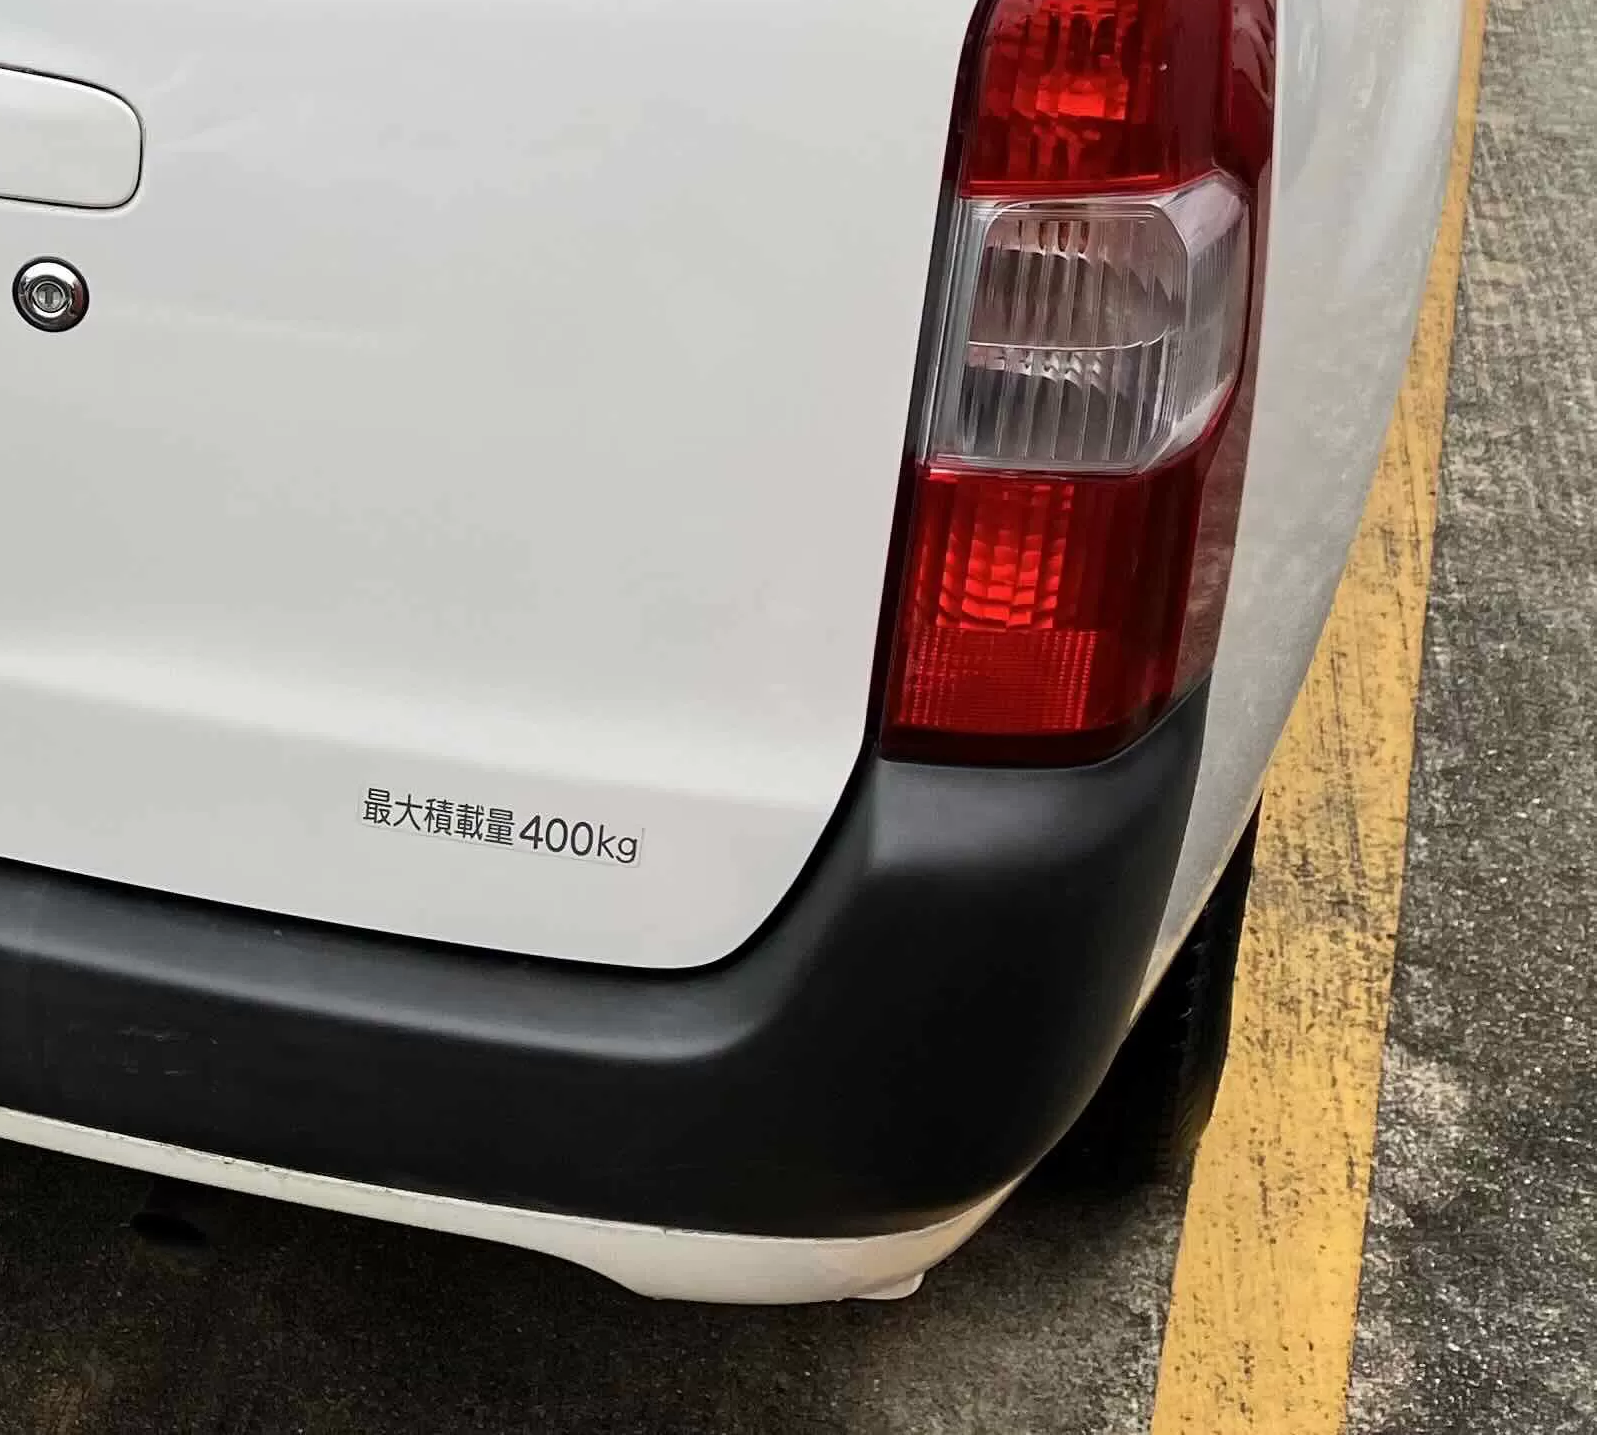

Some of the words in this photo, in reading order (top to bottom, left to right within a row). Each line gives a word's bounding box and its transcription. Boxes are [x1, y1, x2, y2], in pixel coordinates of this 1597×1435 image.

[362, 787, 638, 864] 最大積載量400kg
